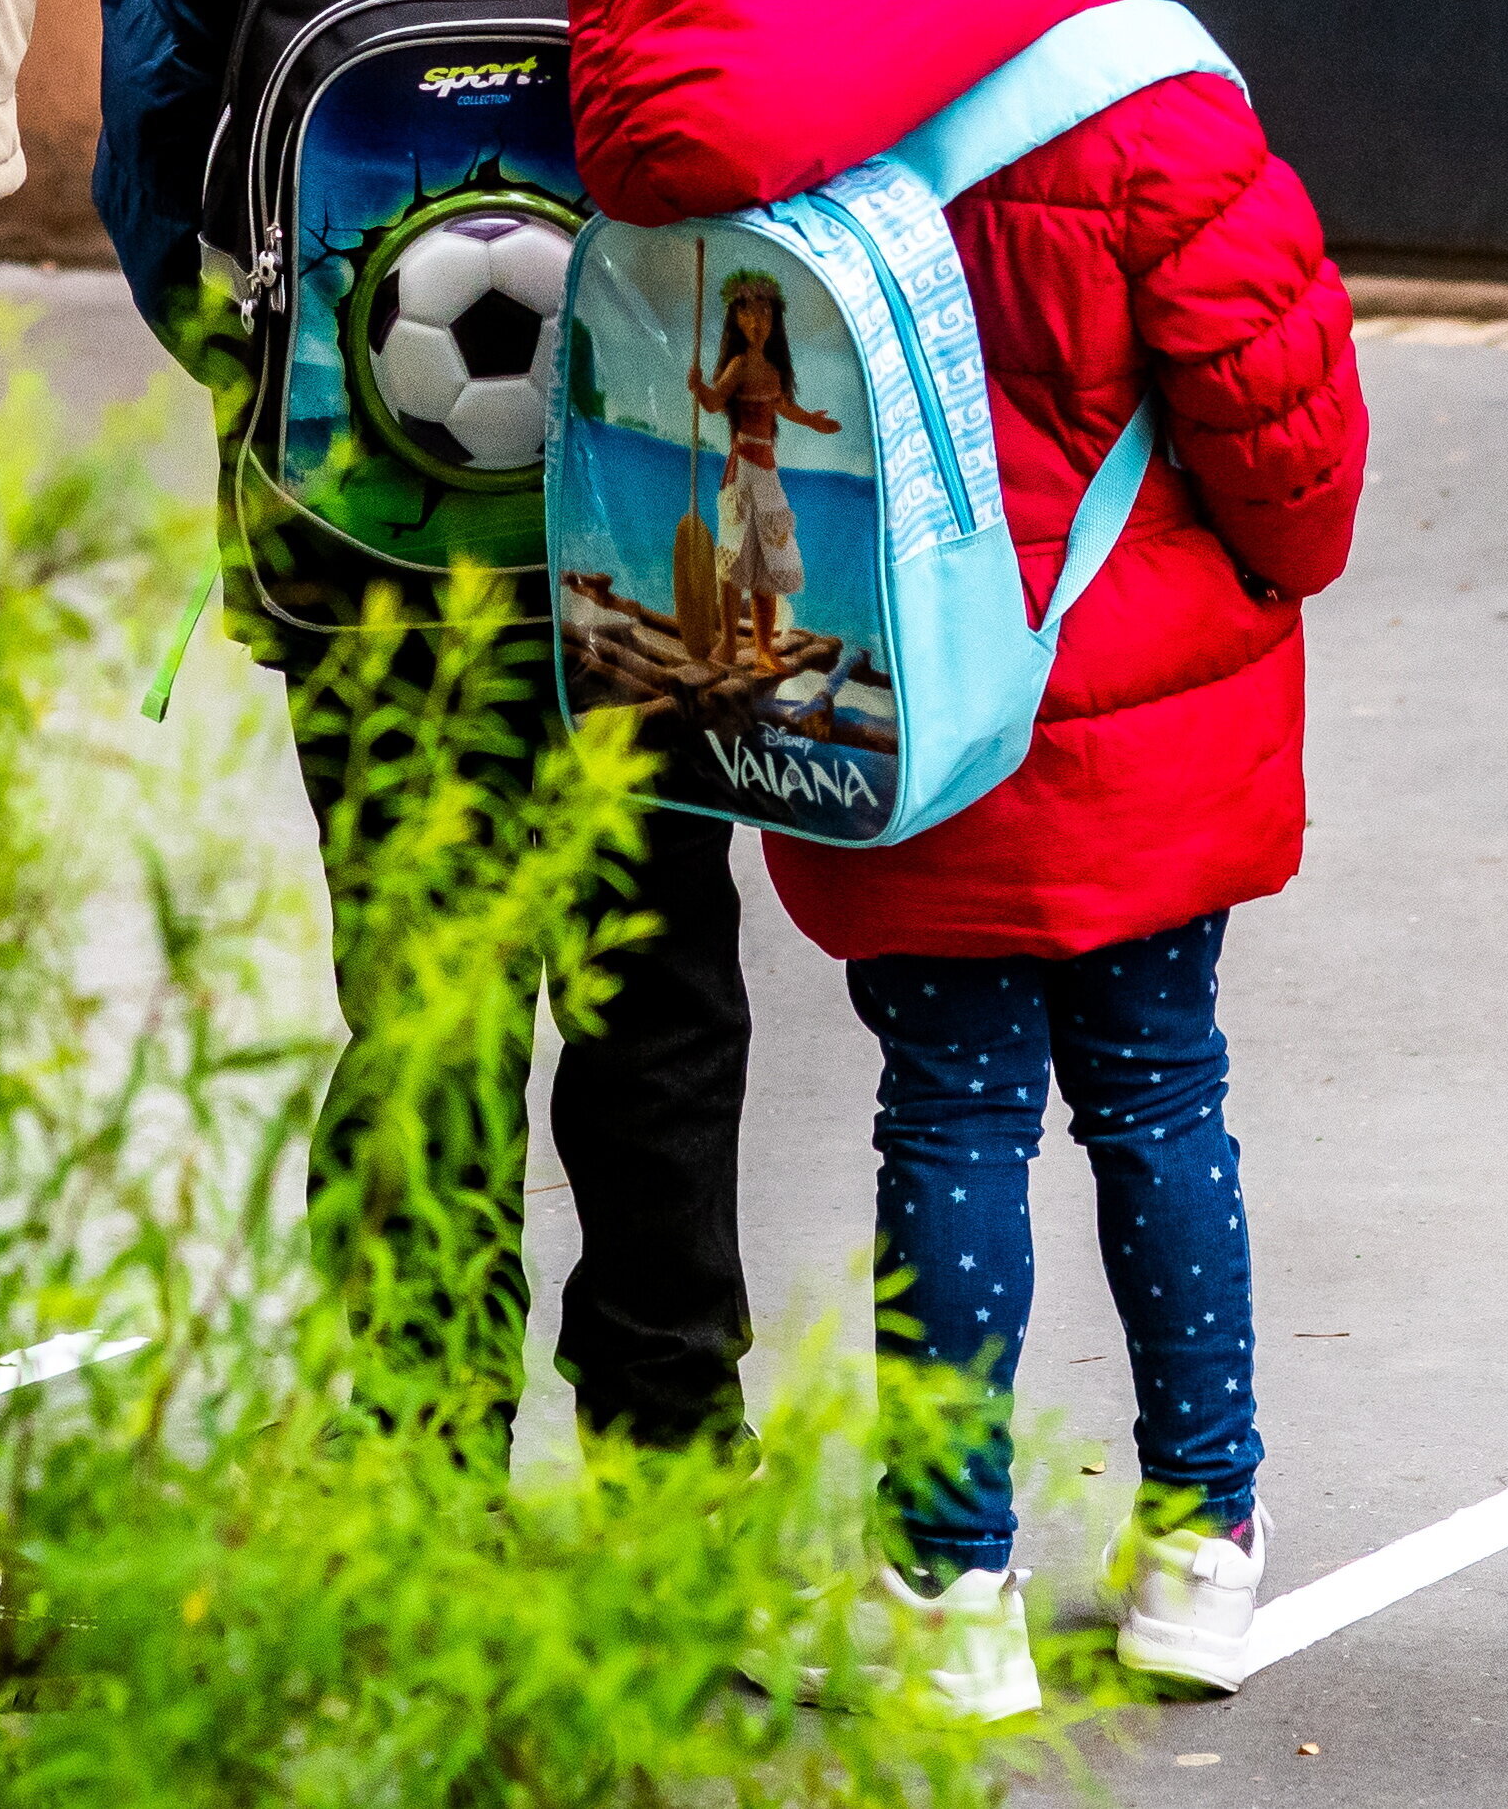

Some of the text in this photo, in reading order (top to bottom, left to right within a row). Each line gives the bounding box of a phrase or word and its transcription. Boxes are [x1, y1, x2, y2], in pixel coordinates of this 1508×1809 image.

[456, 93, 512, 106] COLLECTION
[756, 720, 815, 757] Disney
[703, 728, 880, 809] VAIANA
